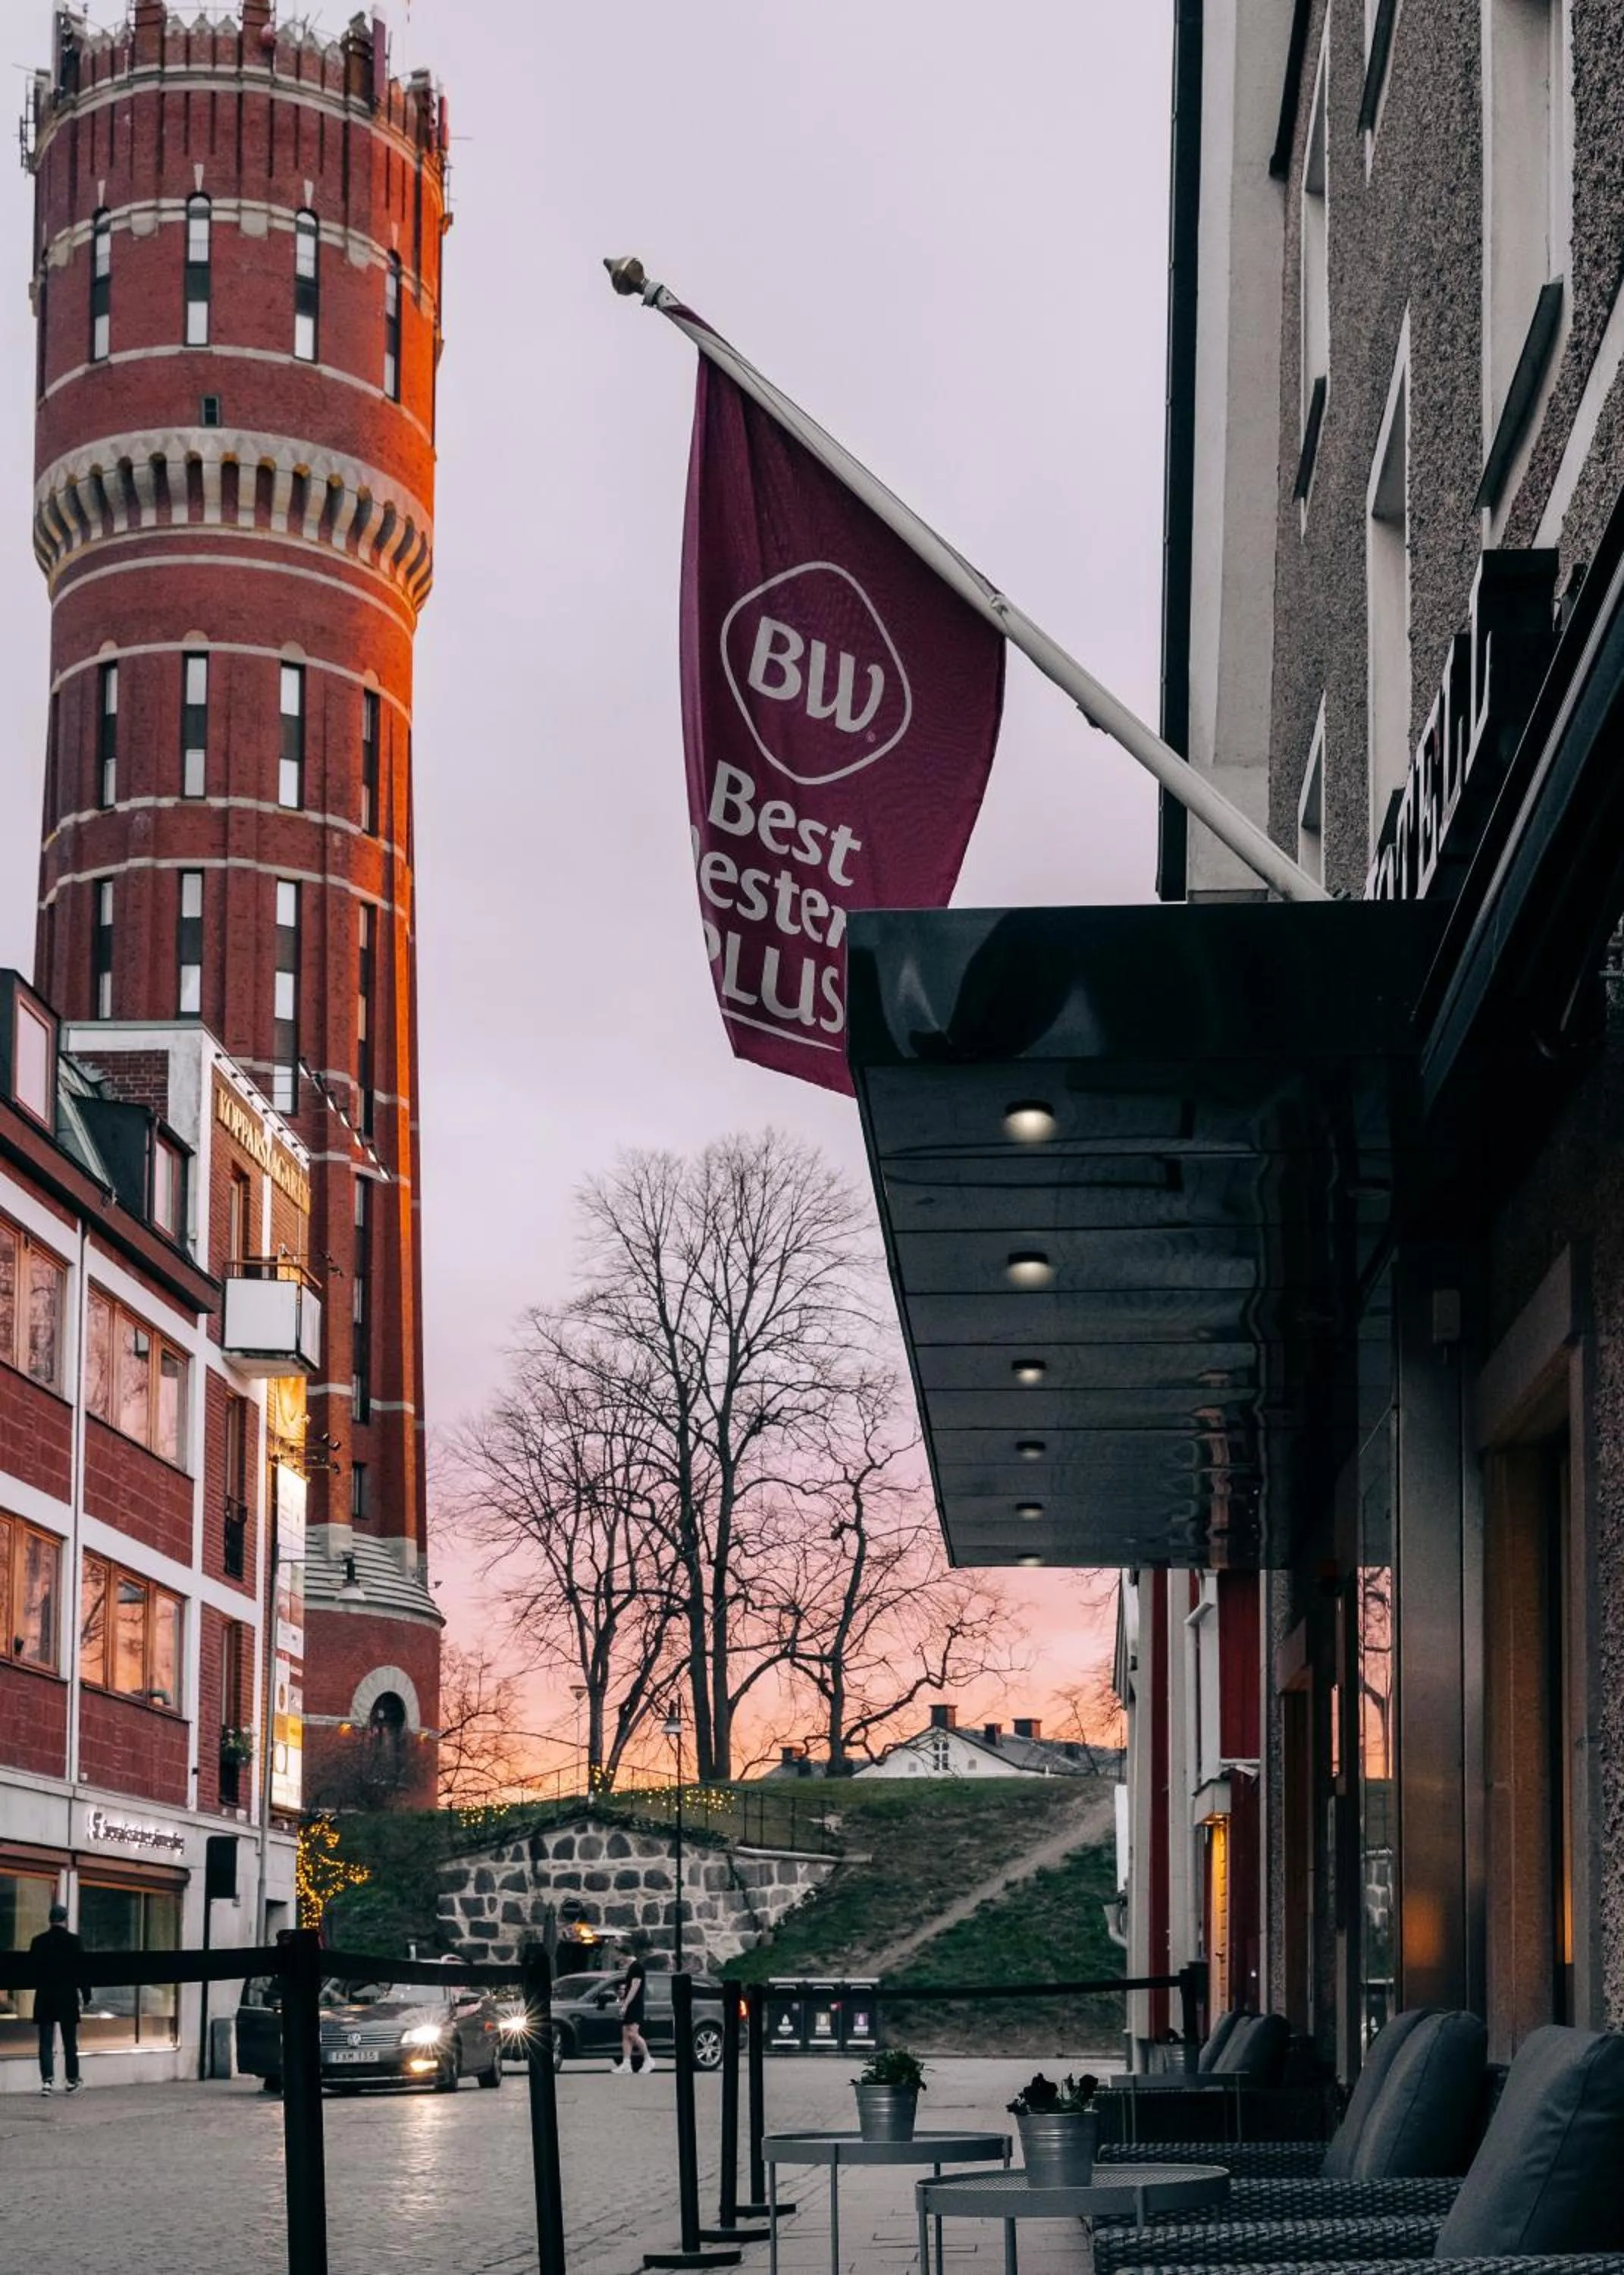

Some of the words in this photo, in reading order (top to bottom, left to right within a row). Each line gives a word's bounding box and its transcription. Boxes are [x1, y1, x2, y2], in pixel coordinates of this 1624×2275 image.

[748, 616, 885, 734] BW
[707, 759, 862, 886] Best
[691, 824, 847, 948] ester
